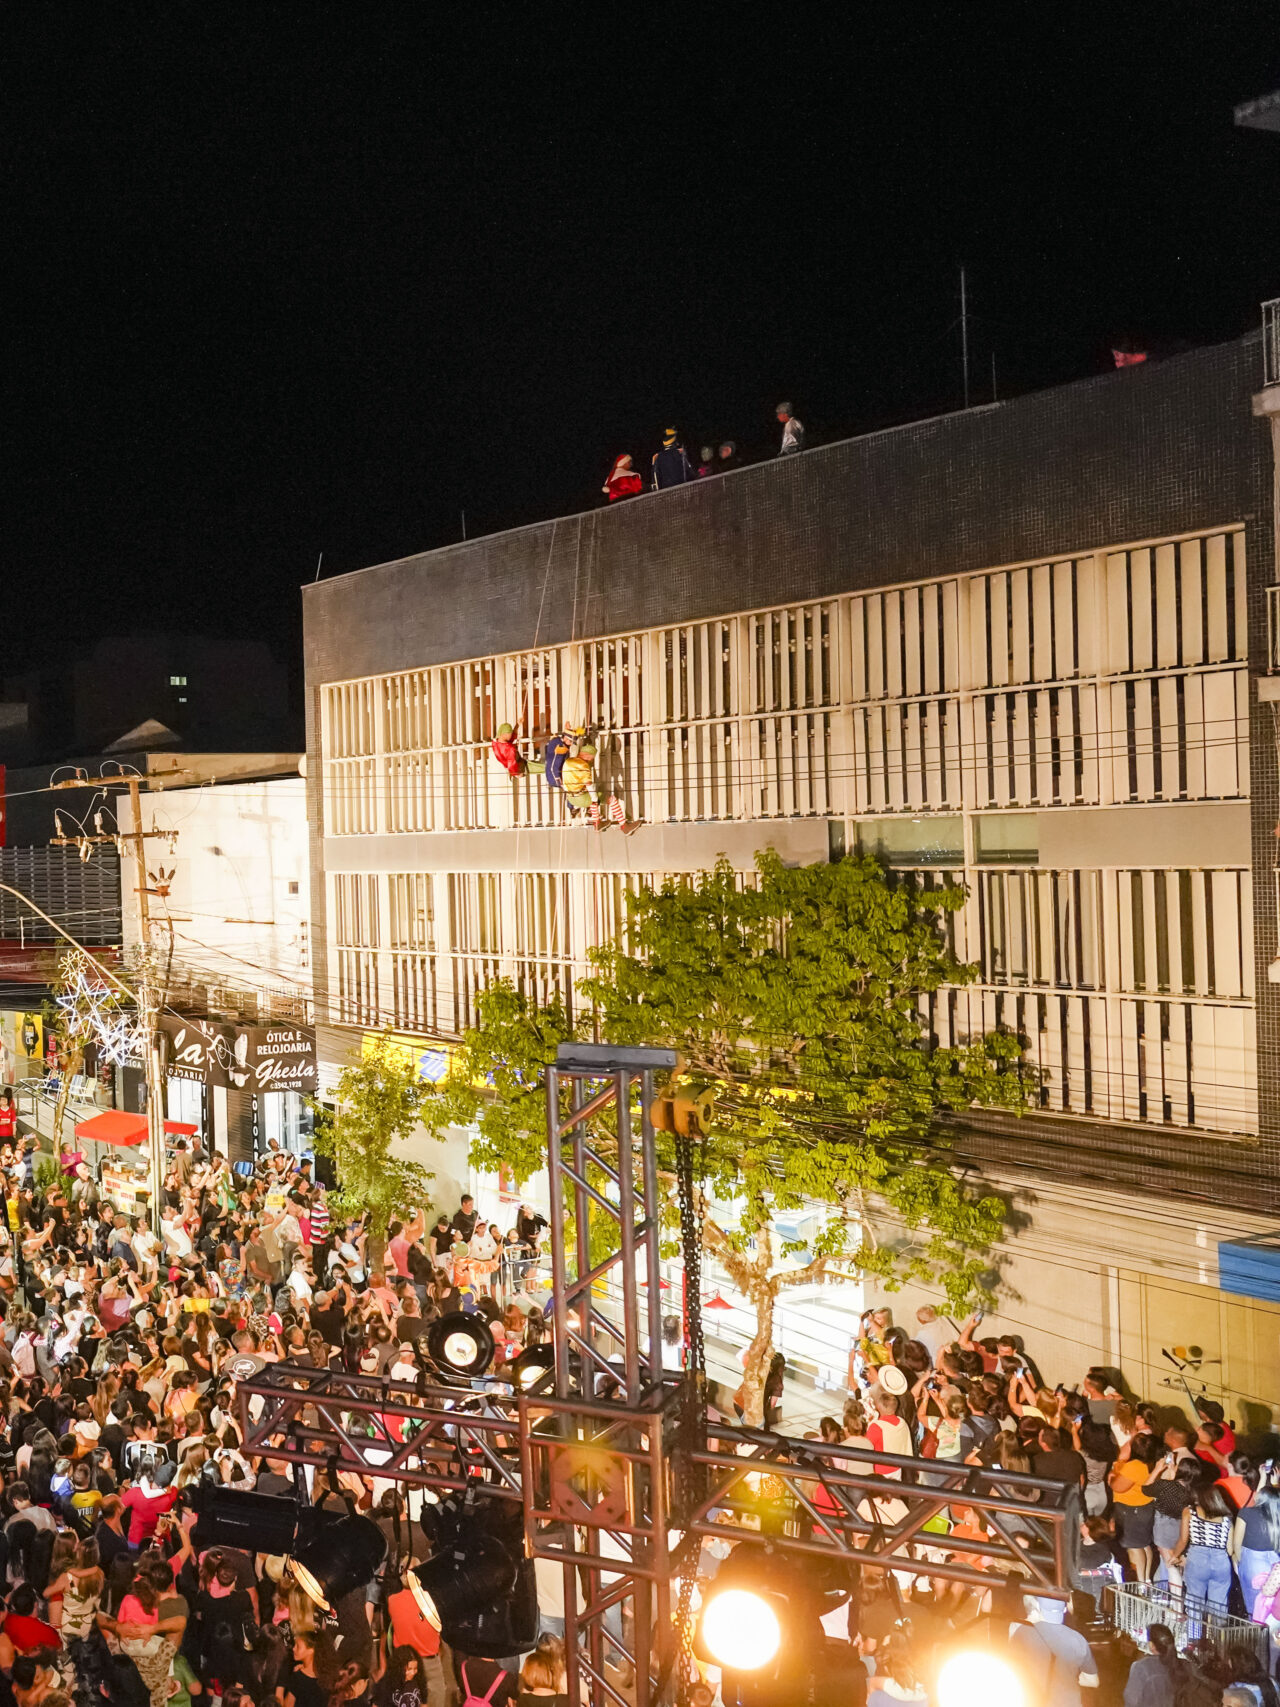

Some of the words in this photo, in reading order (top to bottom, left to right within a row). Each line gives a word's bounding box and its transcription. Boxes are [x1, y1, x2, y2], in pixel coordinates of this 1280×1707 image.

[267, 1030, 294, 1043] ÓTICA
[296, 1031, 302, 1041] E
[257, 1042, 312, 1055] RELOJOARIA
[255, 1058, 315, 1088] Ghesla
